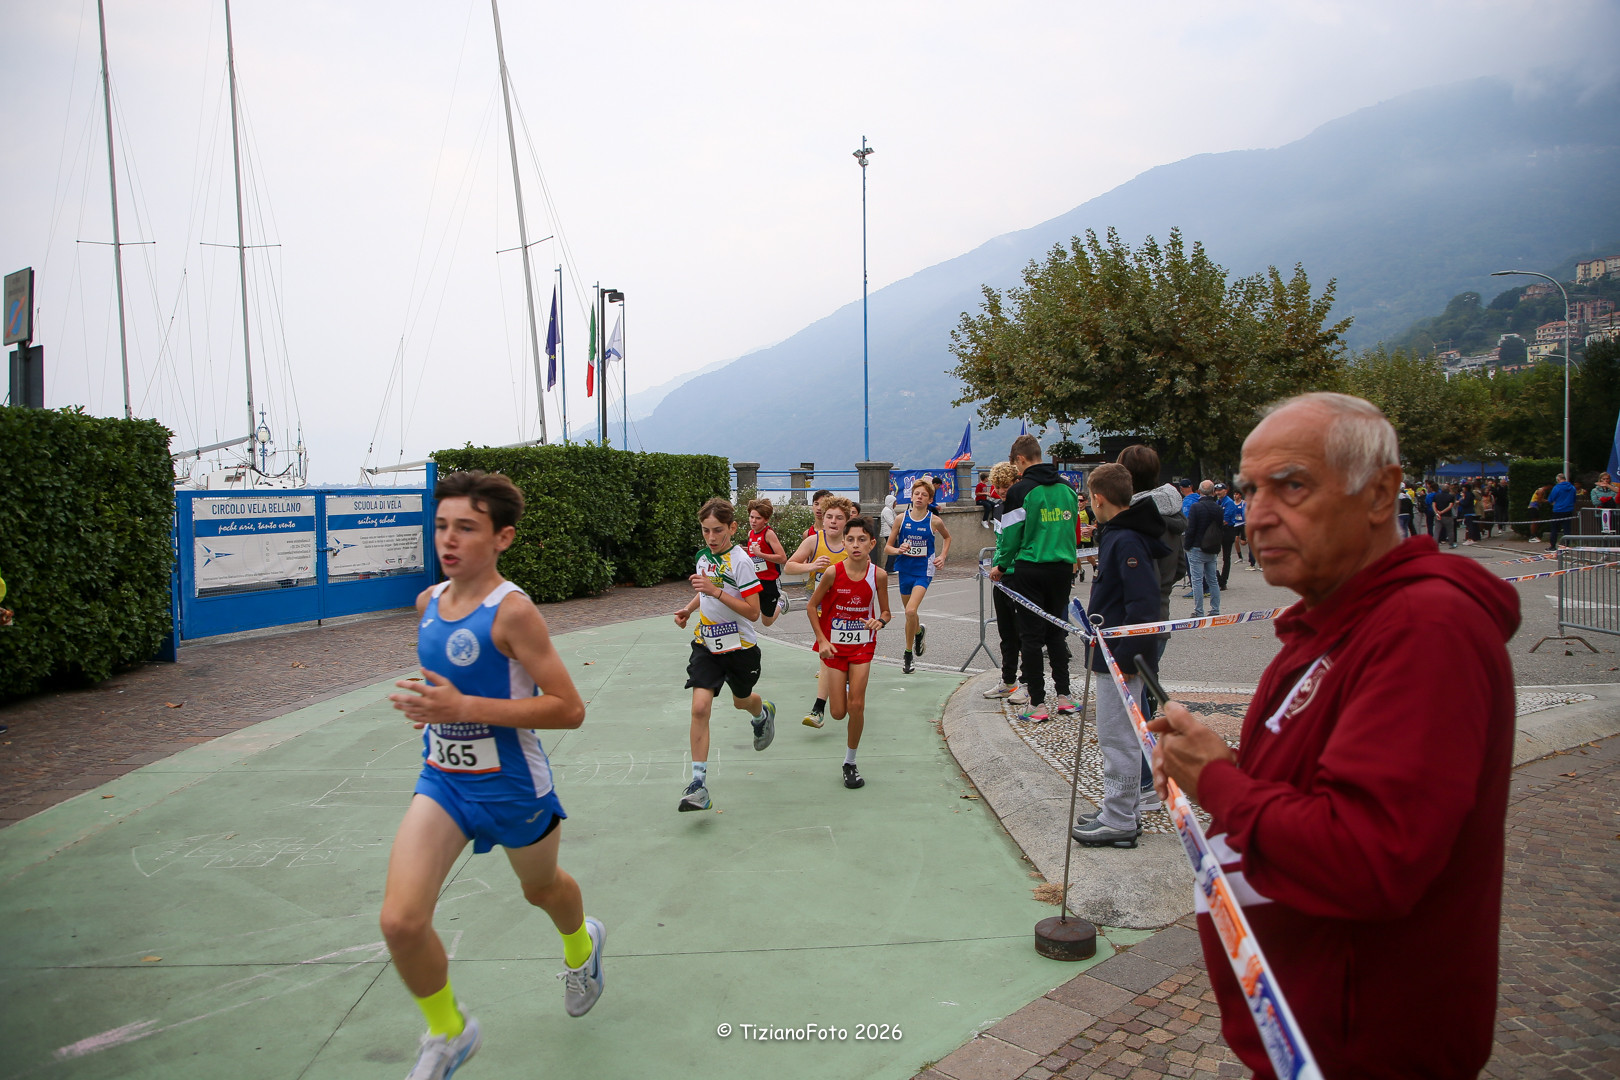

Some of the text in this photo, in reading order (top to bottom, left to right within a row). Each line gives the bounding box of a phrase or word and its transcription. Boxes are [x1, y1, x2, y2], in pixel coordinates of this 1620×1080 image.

[211, 502, 301, 515] CIRCOLO VELA BELLANO
[354, 500, 402, 510] SCUOLA DI VELA
[218, 521, 238, 534] poche
[257, 521, 277, 530] tanto
[278, 520, 296, 529] vento
[357, 514, 396, 527] sailing school
[838, 631, 861, 643] 294
[714, 638, 723, 650] 5
[436, 739, 478, 767] 365
